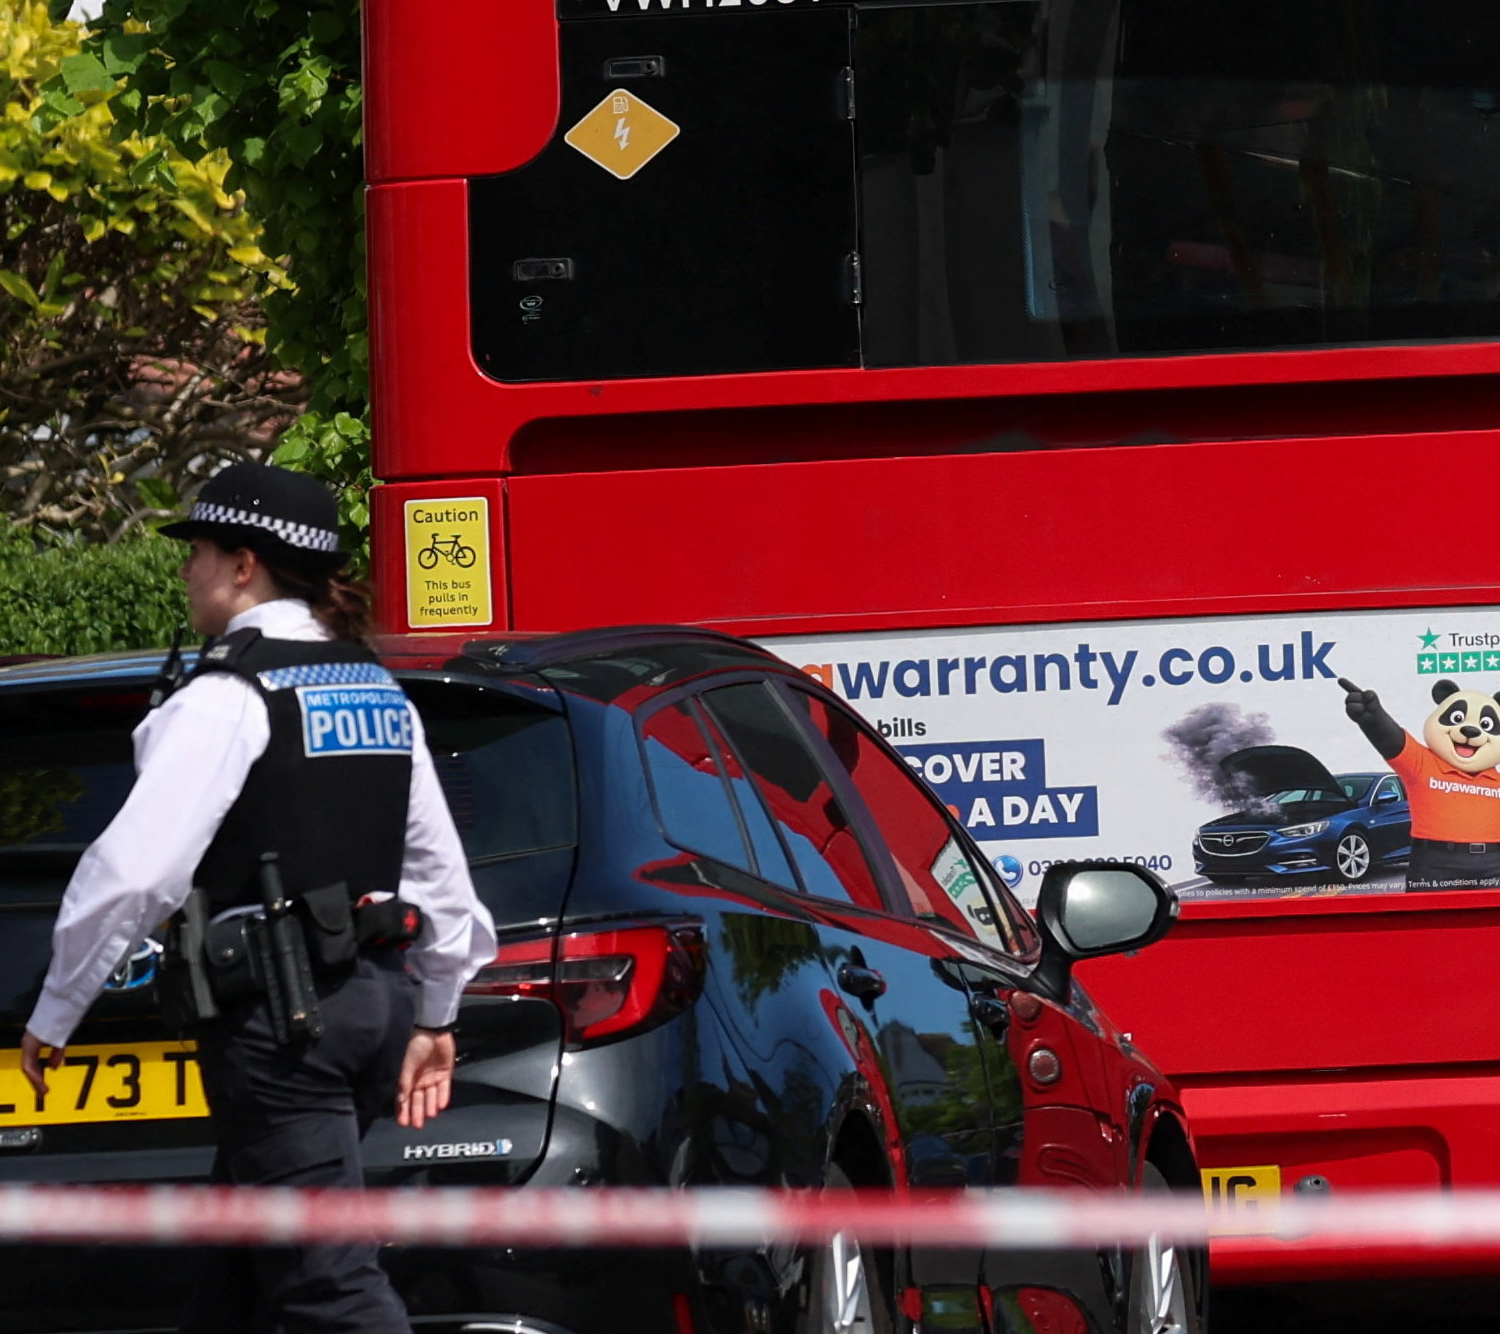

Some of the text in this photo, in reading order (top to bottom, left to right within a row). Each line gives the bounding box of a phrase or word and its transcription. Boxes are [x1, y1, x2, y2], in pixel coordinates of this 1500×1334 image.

[412, 508, 479, 524] Caution
[425, 579, 471, 590] This bus
[428, 593, 469, 605] pulls in
[420, 605, 479, 617] frequently
[310, 708, 412, 749] POLICE
[967, 793, 1084, 828] A DAY
[1206, 888, 1233, 898] policies
[1234, 888, 1250, 896] with
[1258, 886, 1293, 895] minimum
[1372, 883, 1388, 893] may
[1408, 879, 1431, 887] Terms
[1440, 877, 1478, 886] conditions
[403, 1142, 496, 1159] HYBRID
